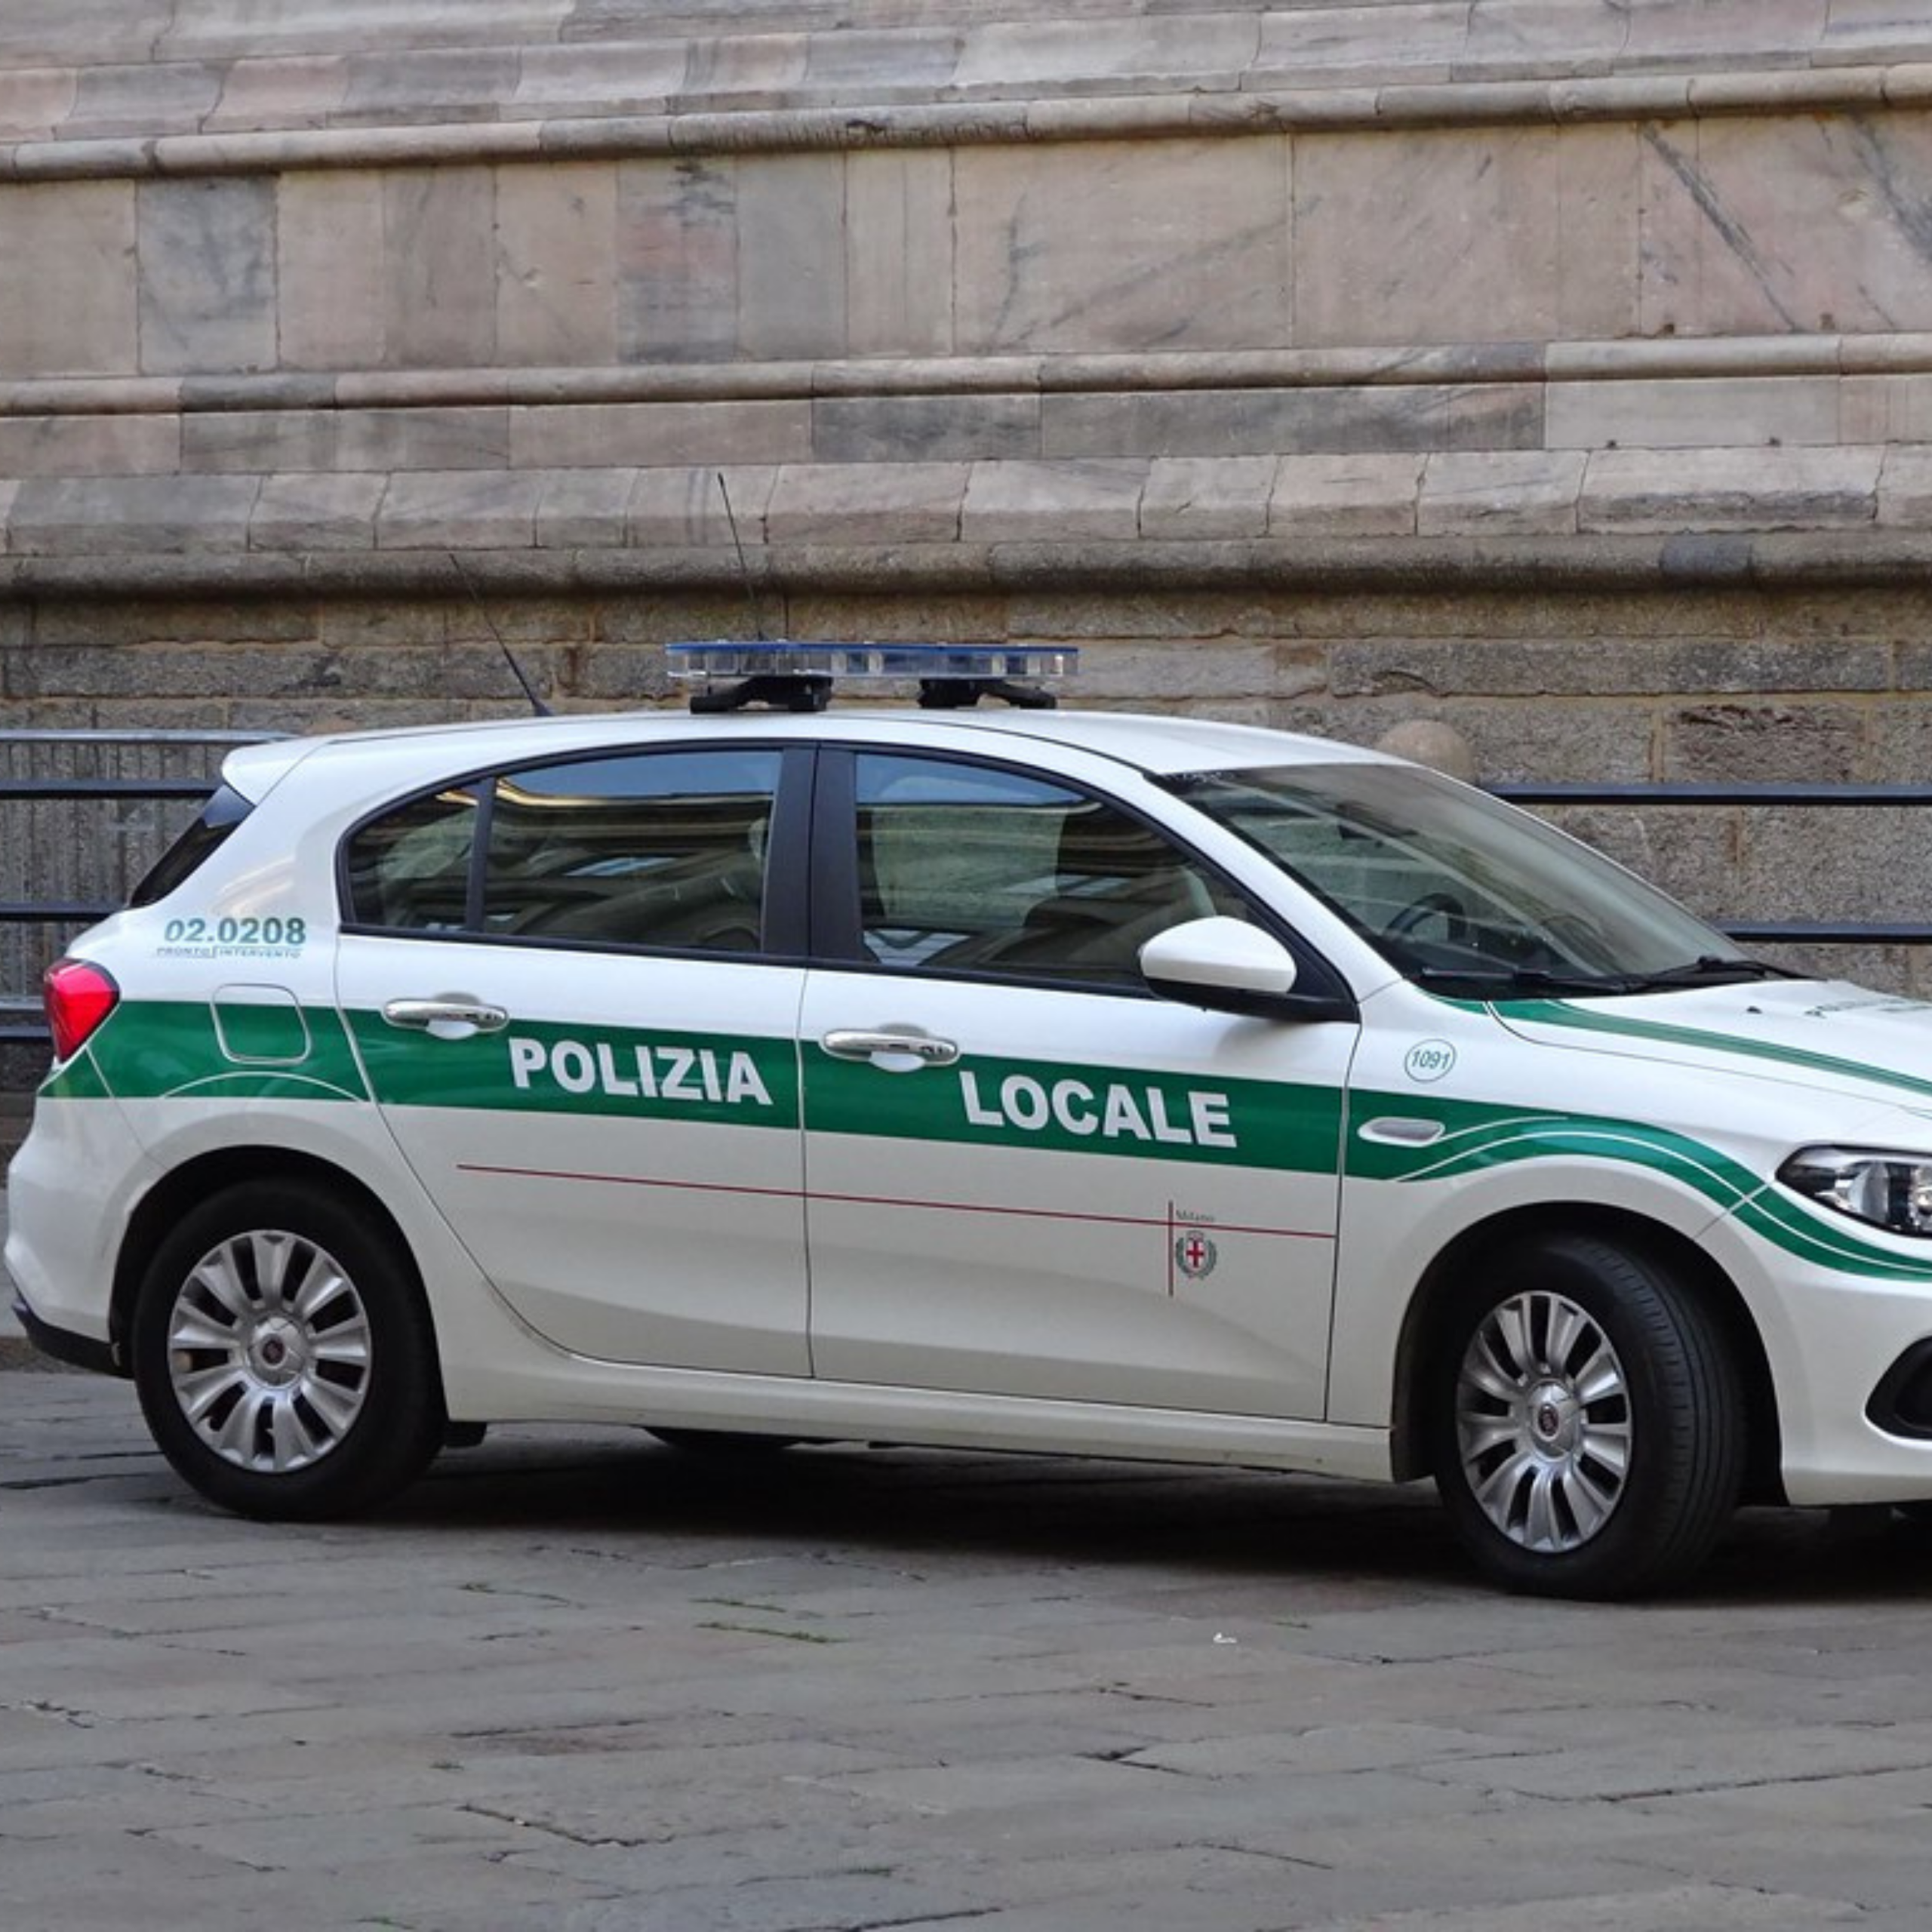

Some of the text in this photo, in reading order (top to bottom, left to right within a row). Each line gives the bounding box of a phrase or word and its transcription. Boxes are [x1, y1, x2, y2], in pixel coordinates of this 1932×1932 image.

[164, 916, 306, 946] 02.0208
[1411, 1050, 1450, 1069] 1091
[509, 1037, 1237, 1149] POLIZIA LOCALE
